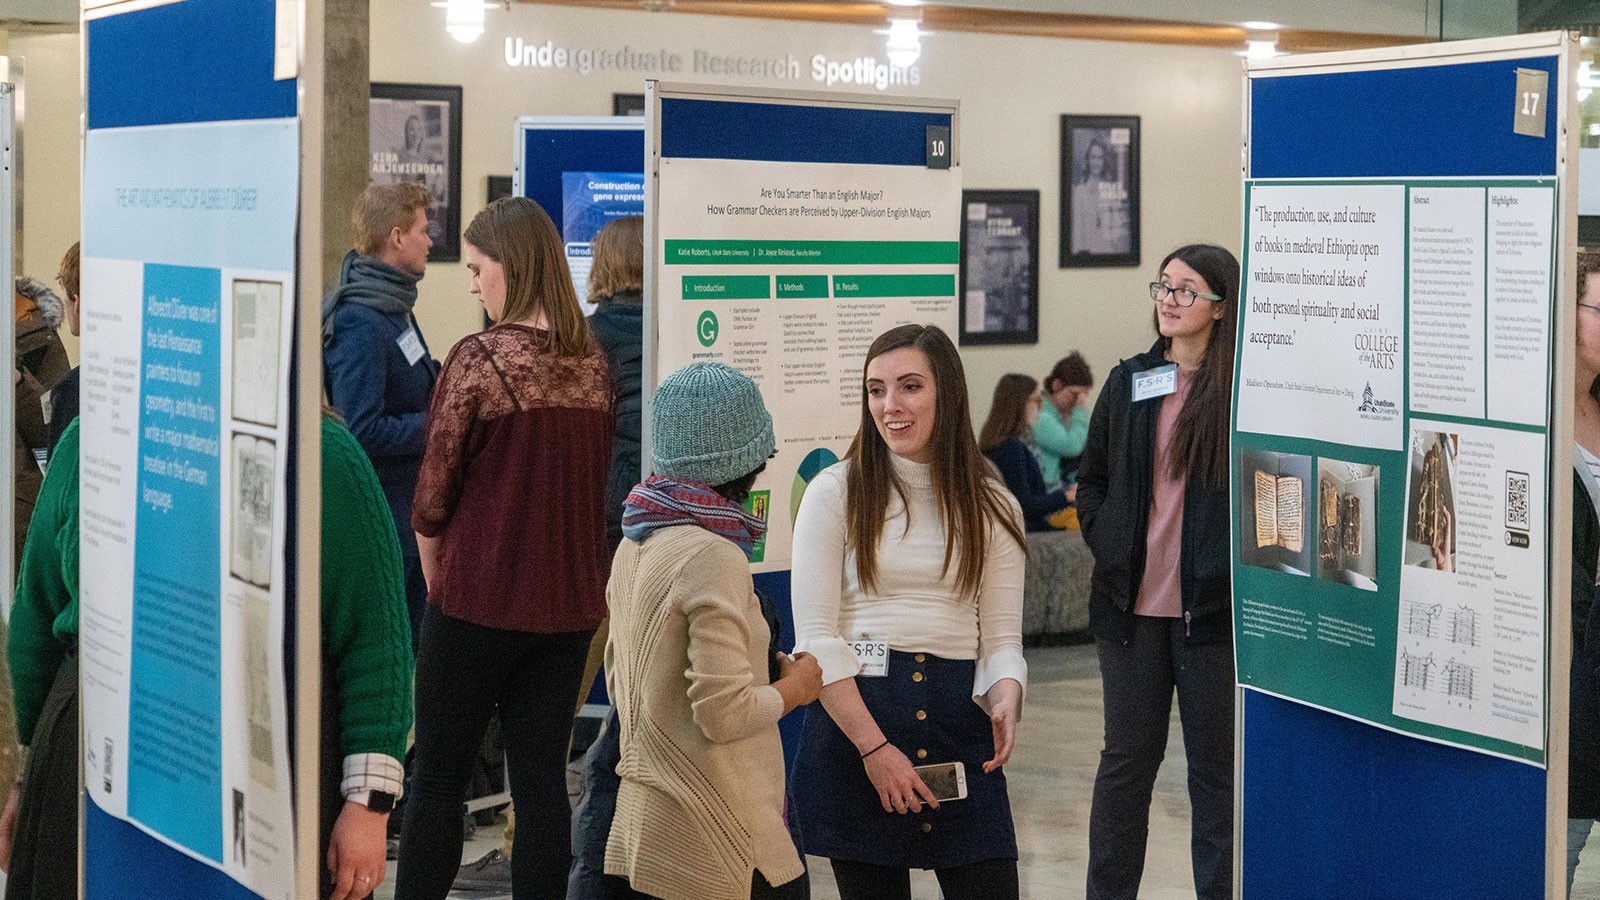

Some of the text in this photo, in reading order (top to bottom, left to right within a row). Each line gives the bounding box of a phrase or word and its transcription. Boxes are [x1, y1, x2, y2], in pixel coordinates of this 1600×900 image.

[505, 36, 921, 91] Undergraduate Research Spotlights
[1521, 91, 1540, 116] 17
[931, 140, 945, 157] 10
[588, 181, 640, 191] Construction
[593, 193, 613, 202] gene
[760, 188, 883, 203] Are You Smarter Than an English Major?
[707, 204, 932, 220] How Grammar Checkers are Perceived by Upper-Division English Majors
[1273, 205, 1315, 227] production,
[1317, 211, 1331, 225] use,
[1333, 206, 1348, 223] and
[1349, 206, 1377, 223] culture
[677, 248, 690, 256] Katie
[691, 248, 711, 257] Roberts,
[1254, 235, 1380, 262] of books in medieval Ethiopia open
[1254, 267, 1368, 288] windows onto historical ideas of
[694, 283, 726, 293] Introduction
[784, 282, 805, 292] Methods
[842, 282, 859, 292] Results
[1252, 296, 1379, 324] both personal spirituality and social
[1354, 333, 1399, 353] COLLEGE
[1369, 353, 1395, 370] ARTS
